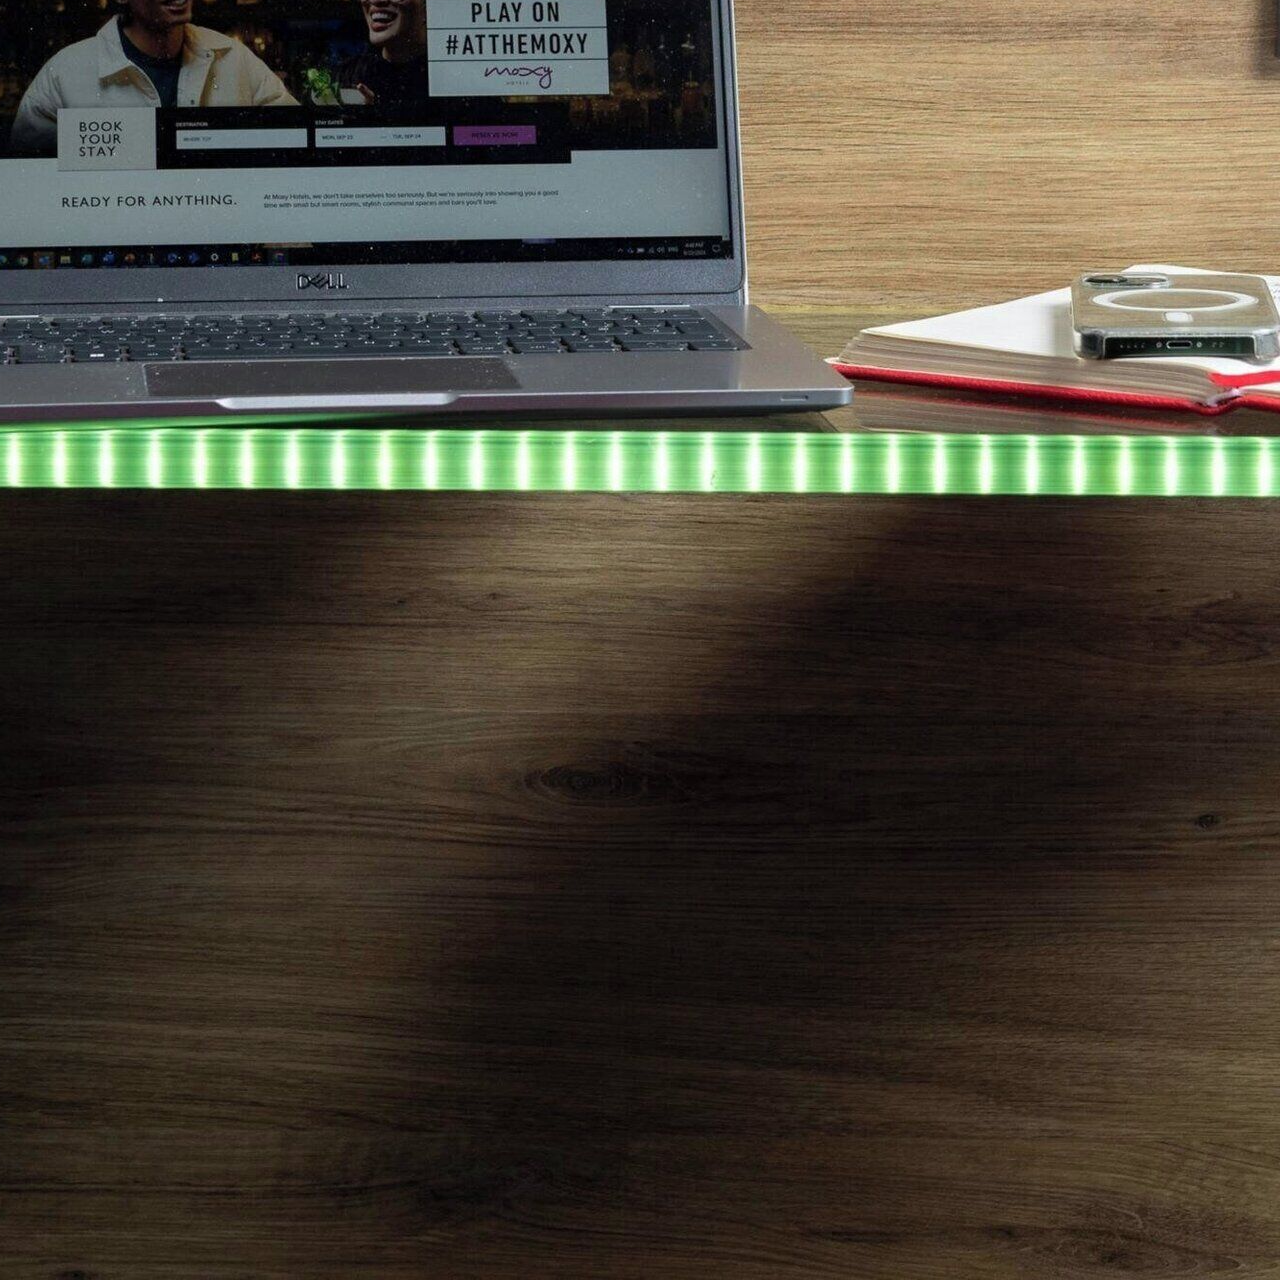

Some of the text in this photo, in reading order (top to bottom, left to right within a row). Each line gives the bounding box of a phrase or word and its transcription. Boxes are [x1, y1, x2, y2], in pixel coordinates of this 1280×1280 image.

[471, 1, 559, 23] PLAY ON
[446, 33, 588, 55] #ATTHEMOXY
[79, 121, 123, 132] BOOK
[79, 133, 121, 144] YOUR
[79, 146, 116, 157] STAY
[62, 194, 238, 207] READY FOR ANYTHING.
[296, 273, 349, 290] DELL
